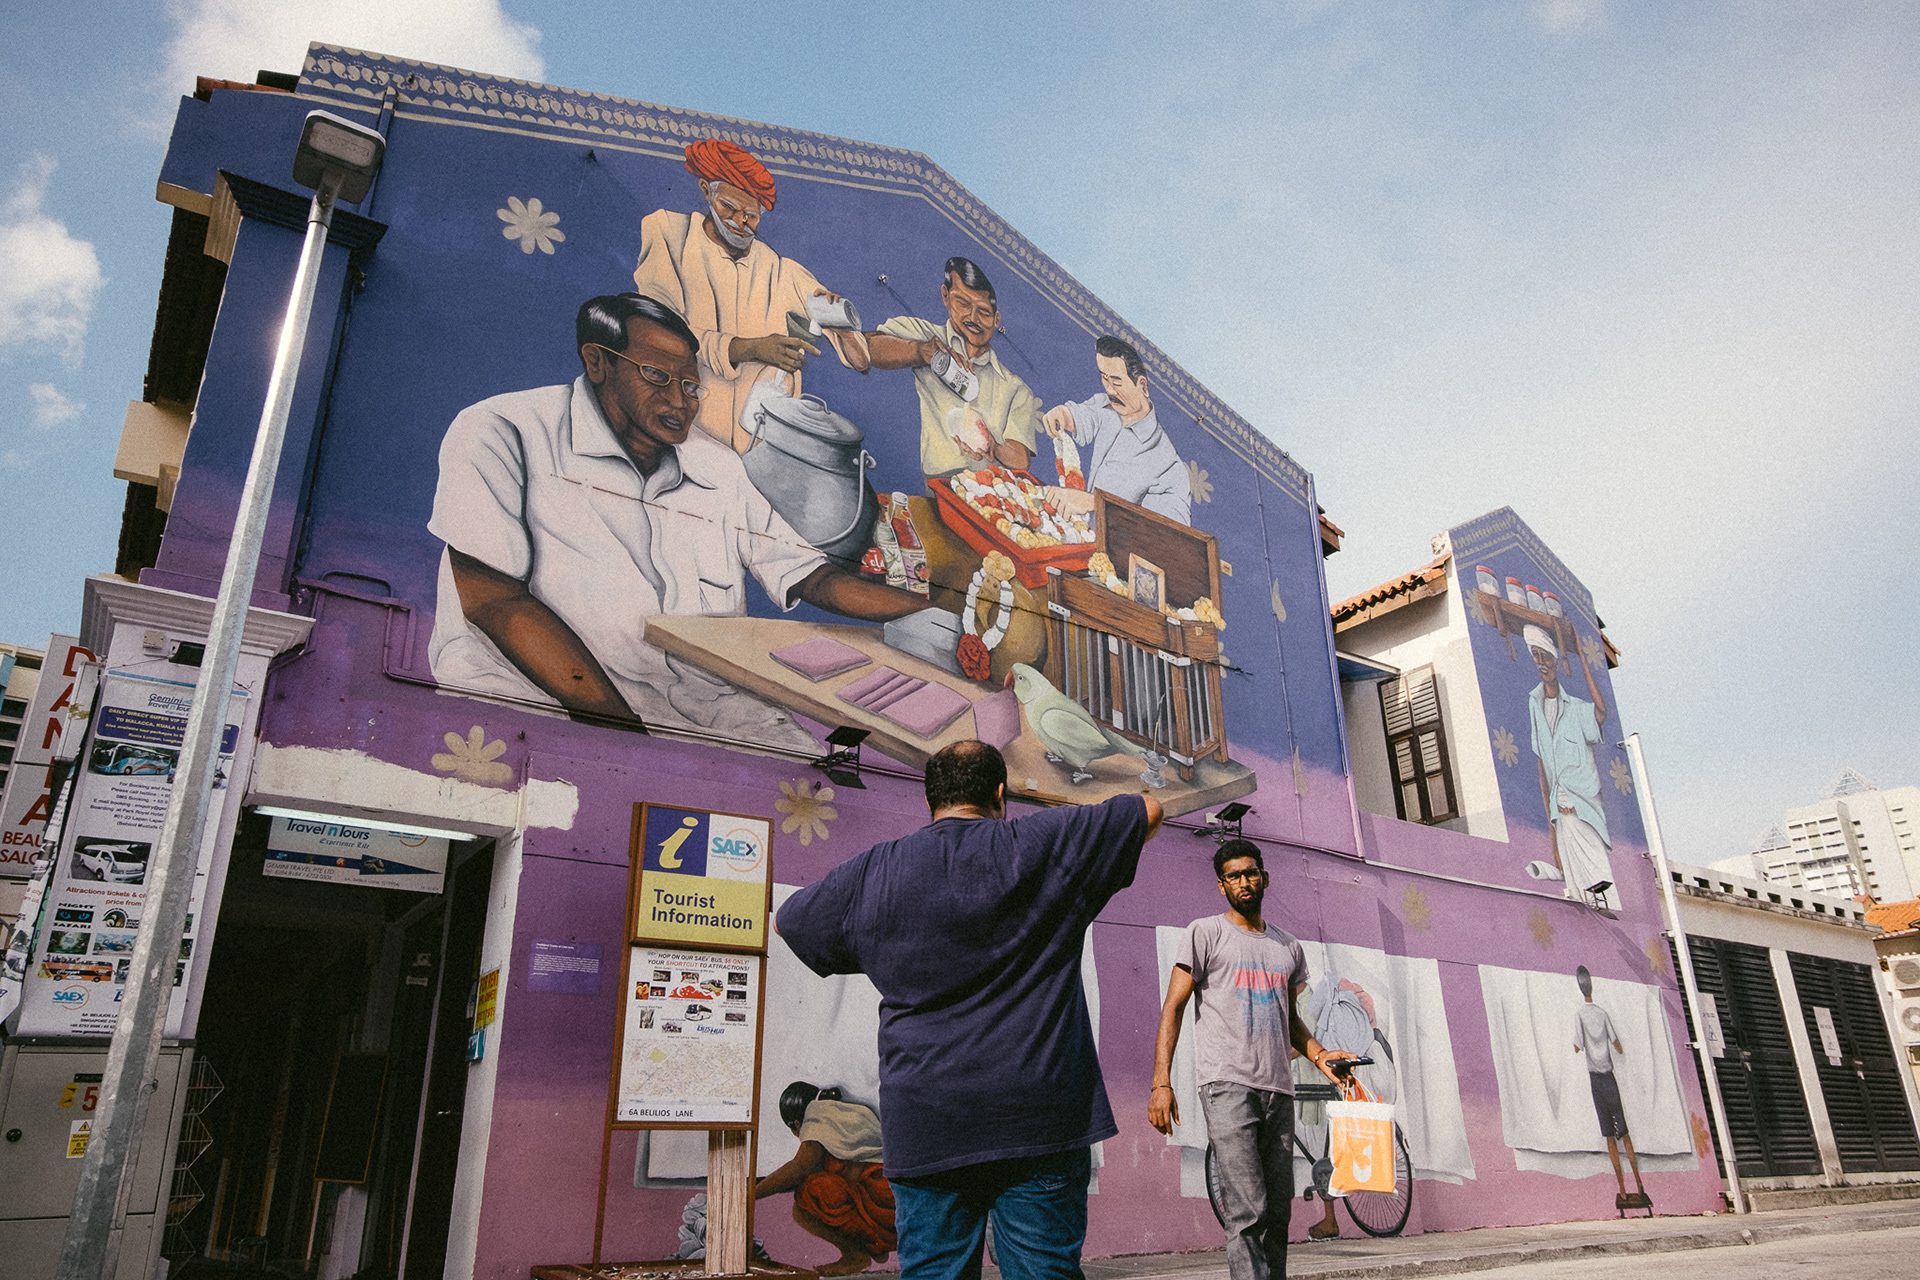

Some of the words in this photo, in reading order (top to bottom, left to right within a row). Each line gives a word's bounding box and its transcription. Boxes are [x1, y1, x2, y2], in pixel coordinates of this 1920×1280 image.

[149, 693, 183, 704] Gemini
[148, 700, 169, 710] Travel
[149, 713, 169, 721] SUPER
[150, 729, 173, 737] packages
[129, 782, 150, 790] Booking
[128, 795, 150, 803] Booking
[90, 804, 114, 812] Boarding
[287, 817, 326, 835] Travel
[339, 825, 370, 841] Tours
[266, 862, 289, 870] GEMINI
[290, 864, 312, 872] TRAVEL
[65, 886, 105, 895] Attractions
[107, 889, 129, 898] tickets
[653, 888, 716, 909] Tourist
[651, 906, 753, 930] Information
[666, 960, 698, 968] SHORTCUT
[708, 963, 750, 972] ATTRACTIONS!
[82, 1086, 98, 1112] 5
[628, 1108, 639, 1116] 6A
[640, 1109, 671, 1117] BELILIOS
[675, 1110, 694, 1118] LANE
